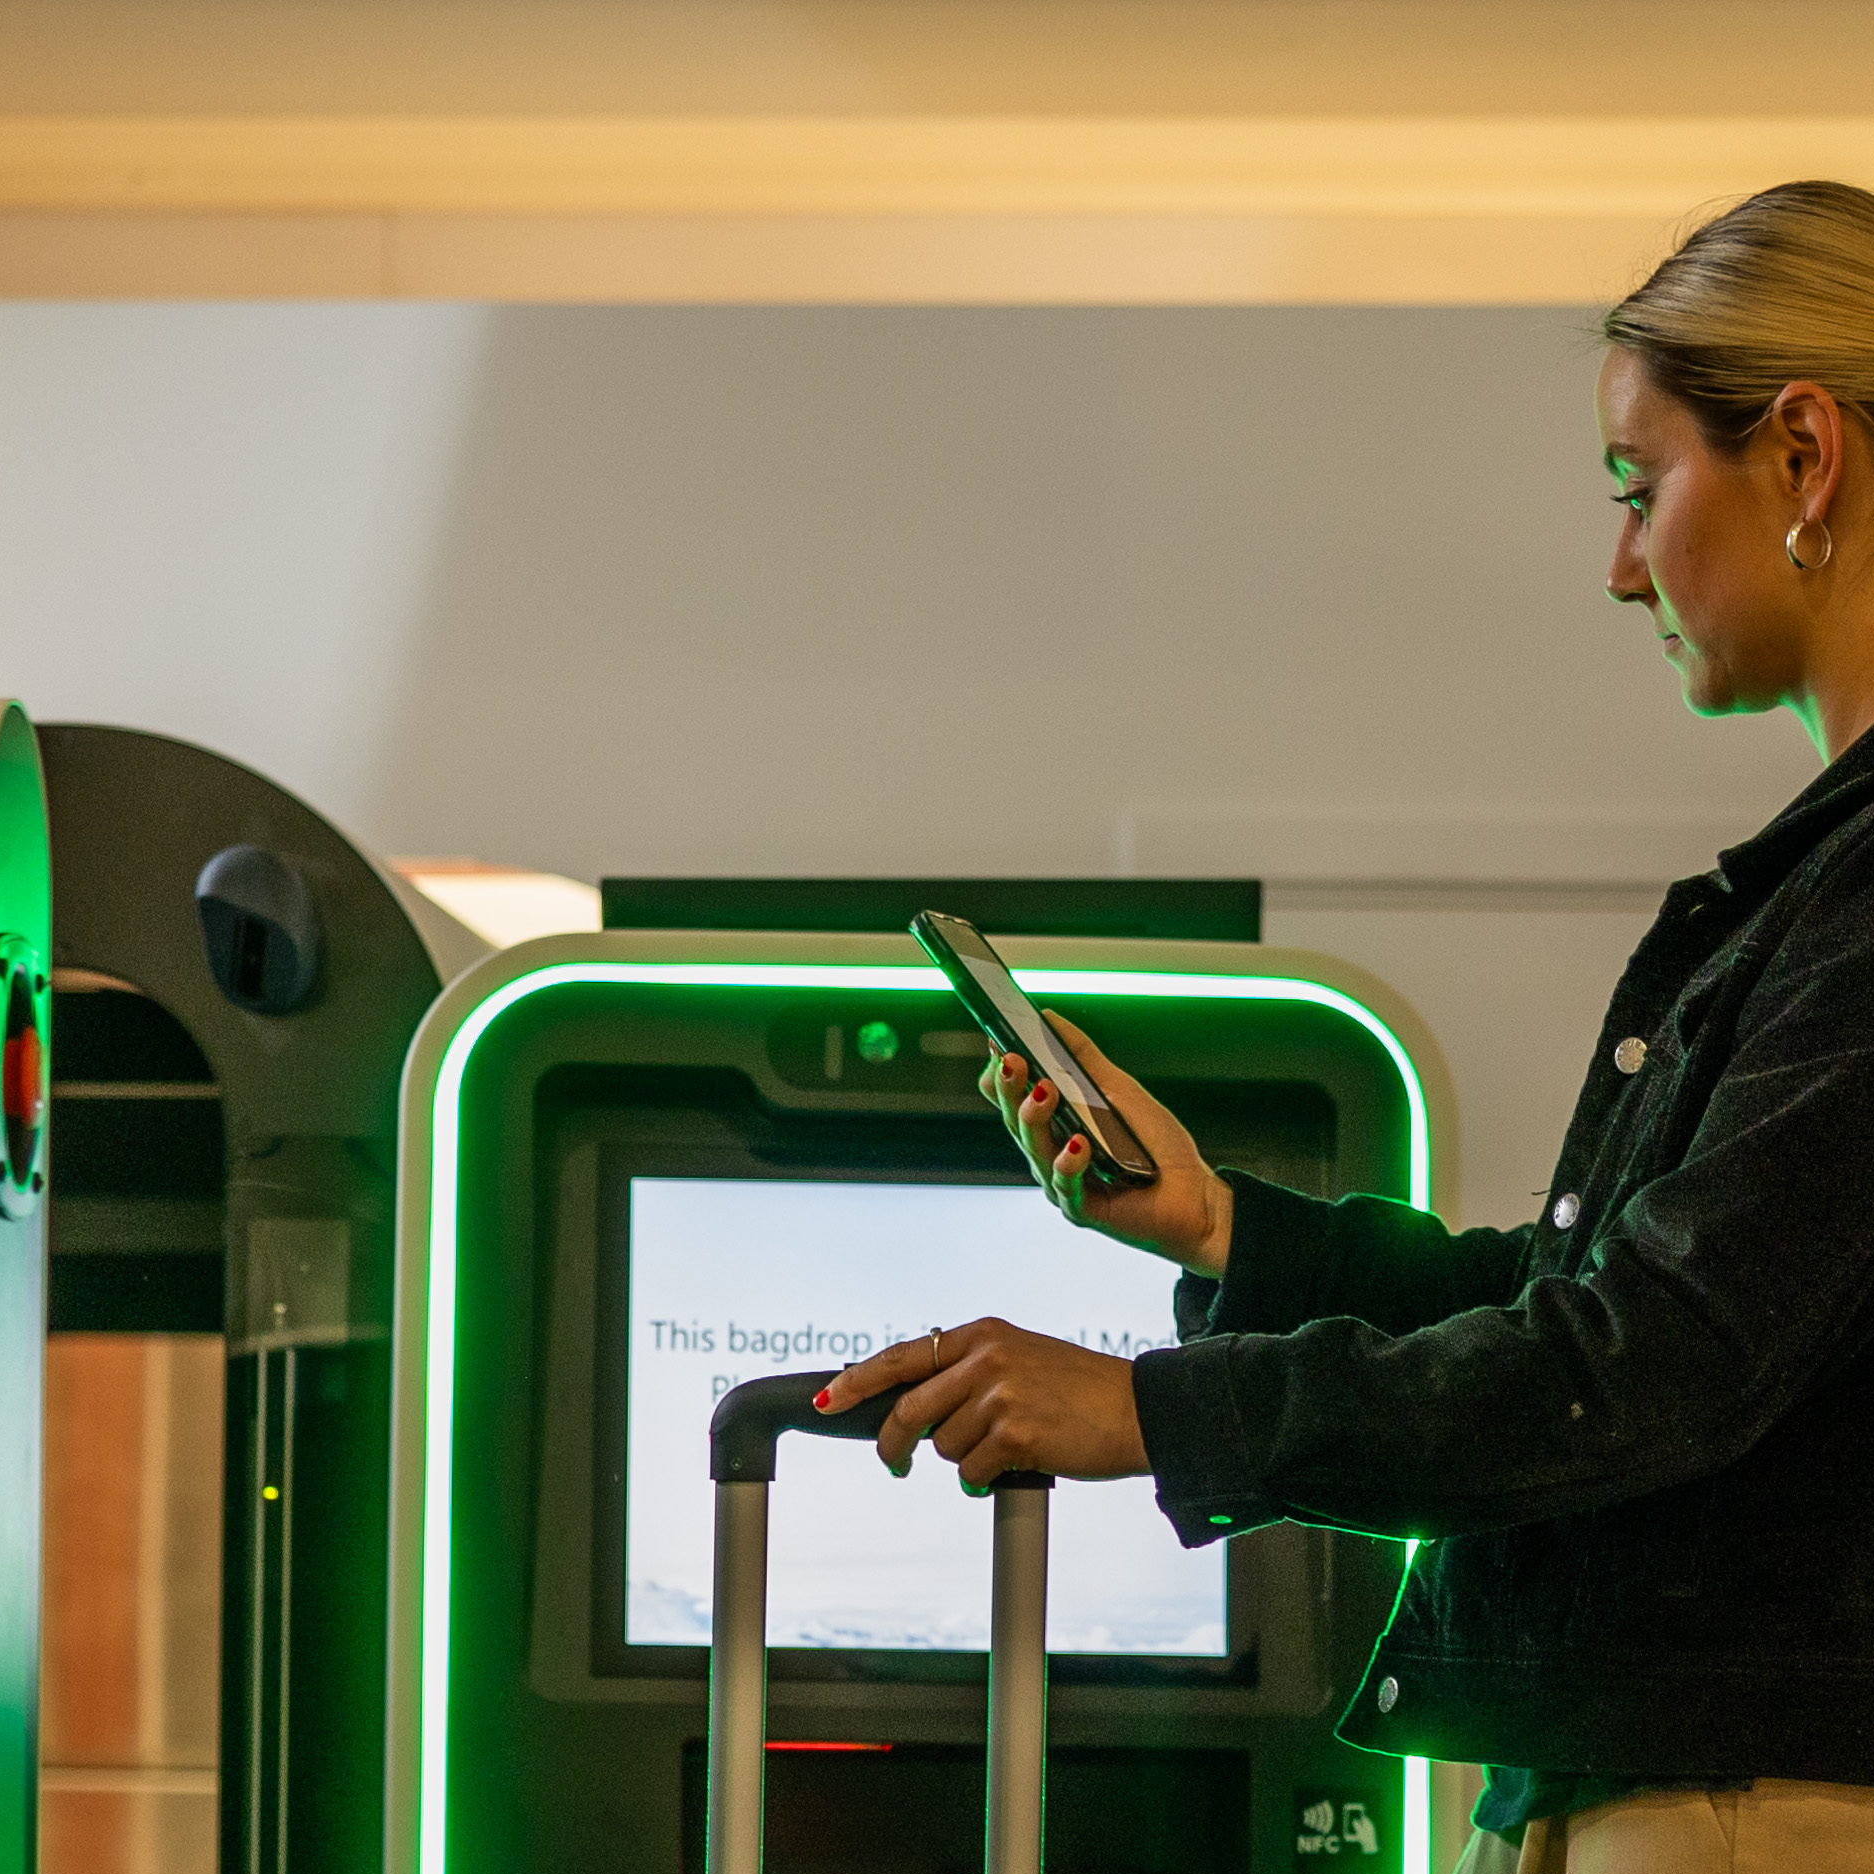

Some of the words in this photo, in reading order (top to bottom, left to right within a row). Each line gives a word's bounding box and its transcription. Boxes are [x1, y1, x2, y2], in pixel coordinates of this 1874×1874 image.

[649, 1319, 715, 1352] This
[728, 1320, 872, 1364] bagdrop
[1102, 1330, 1175, 1358] Mod
[1297, 1835, 1339, 1854] NFC
